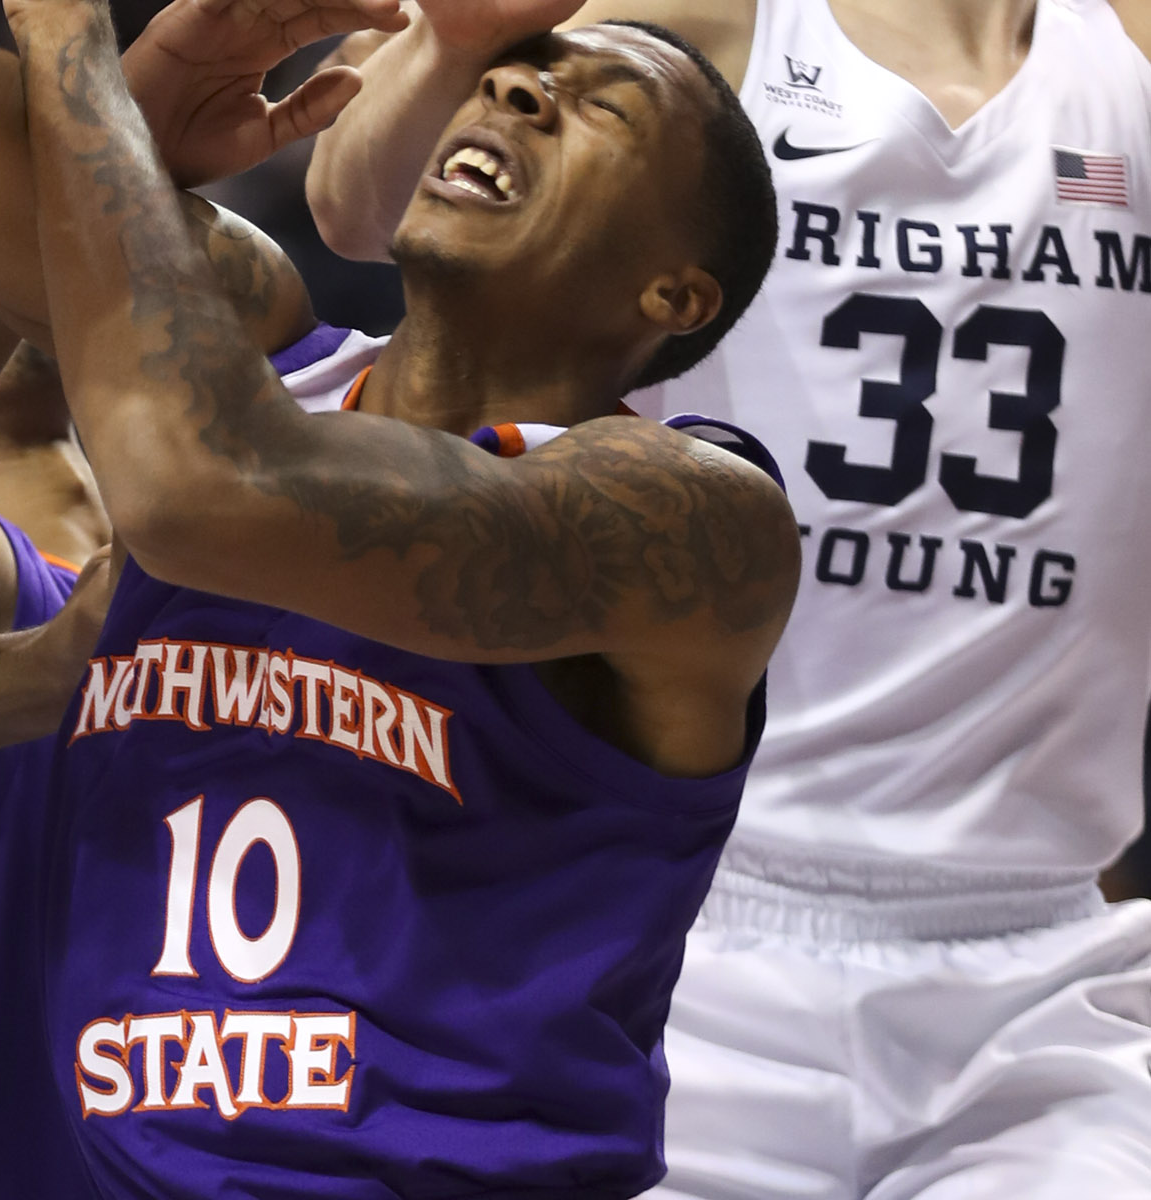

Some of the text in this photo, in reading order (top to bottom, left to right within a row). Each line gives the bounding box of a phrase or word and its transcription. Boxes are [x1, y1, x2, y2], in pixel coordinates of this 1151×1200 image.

[763, 81, 843, 112] WEST COAST
[785, 200, 1151, 295] RIGHAM
[804, 292, 1066, 519] 33
[798, 524, 1076, 608] OUNG
[150, 794, 302, 984] 10
[75, 1007, 357, 1121] STATE
